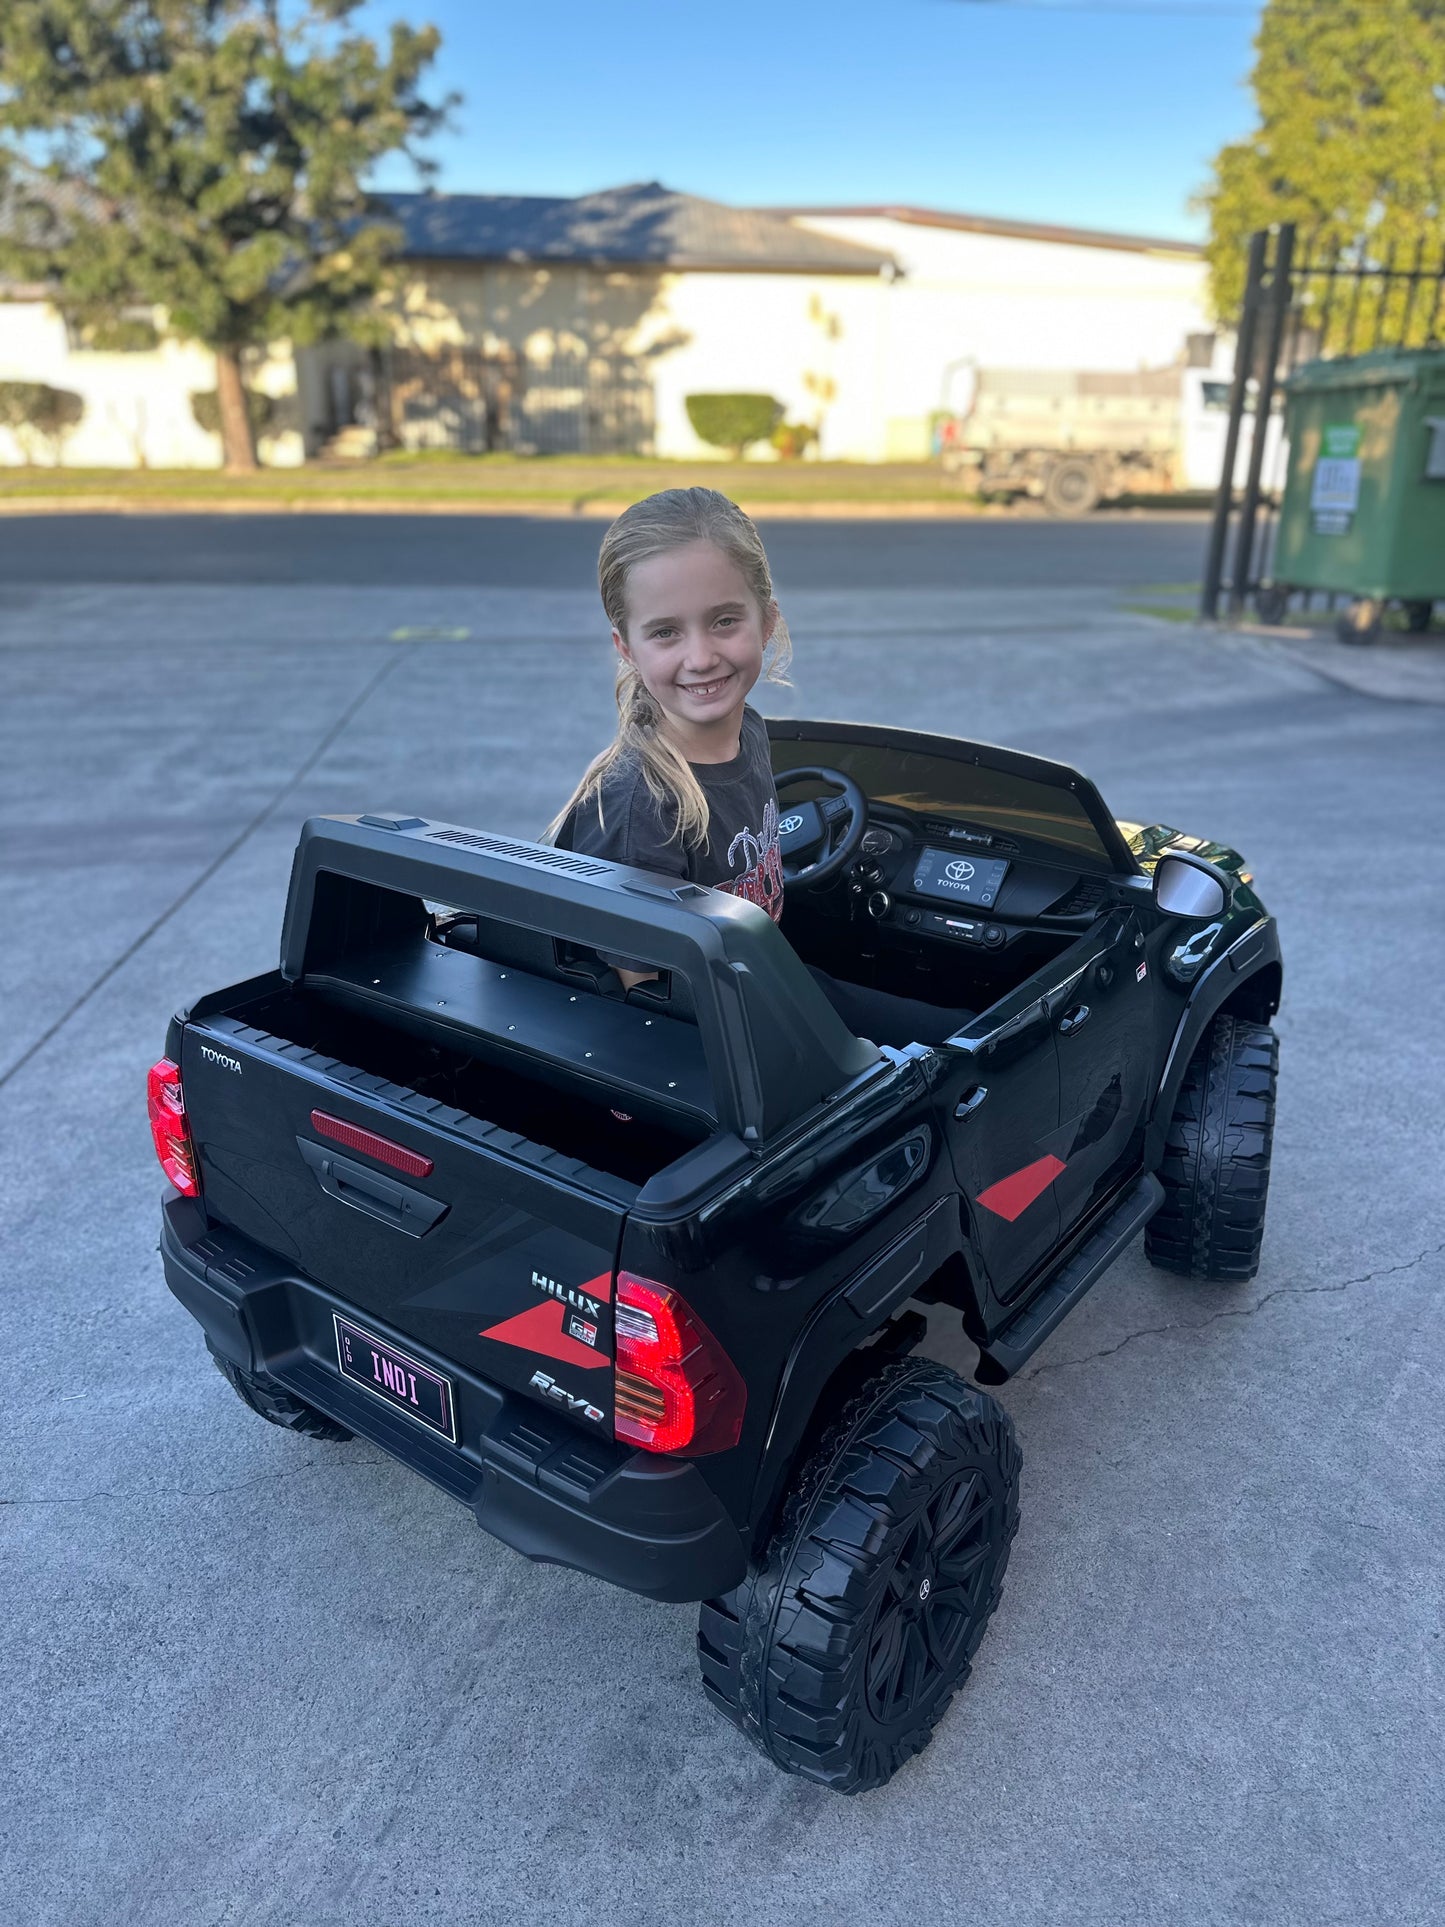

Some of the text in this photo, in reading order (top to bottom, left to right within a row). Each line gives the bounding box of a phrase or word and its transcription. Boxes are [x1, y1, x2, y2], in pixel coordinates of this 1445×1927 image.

[937, 879, 970, 892] TOYOTA
[201, 1046, 242, 1074] TOYOTA
[531, 1271, 600, 1319] HILUX
[370, 1350, 419, 1406] INDI
[528, 1370, 605, 1423] REVO
